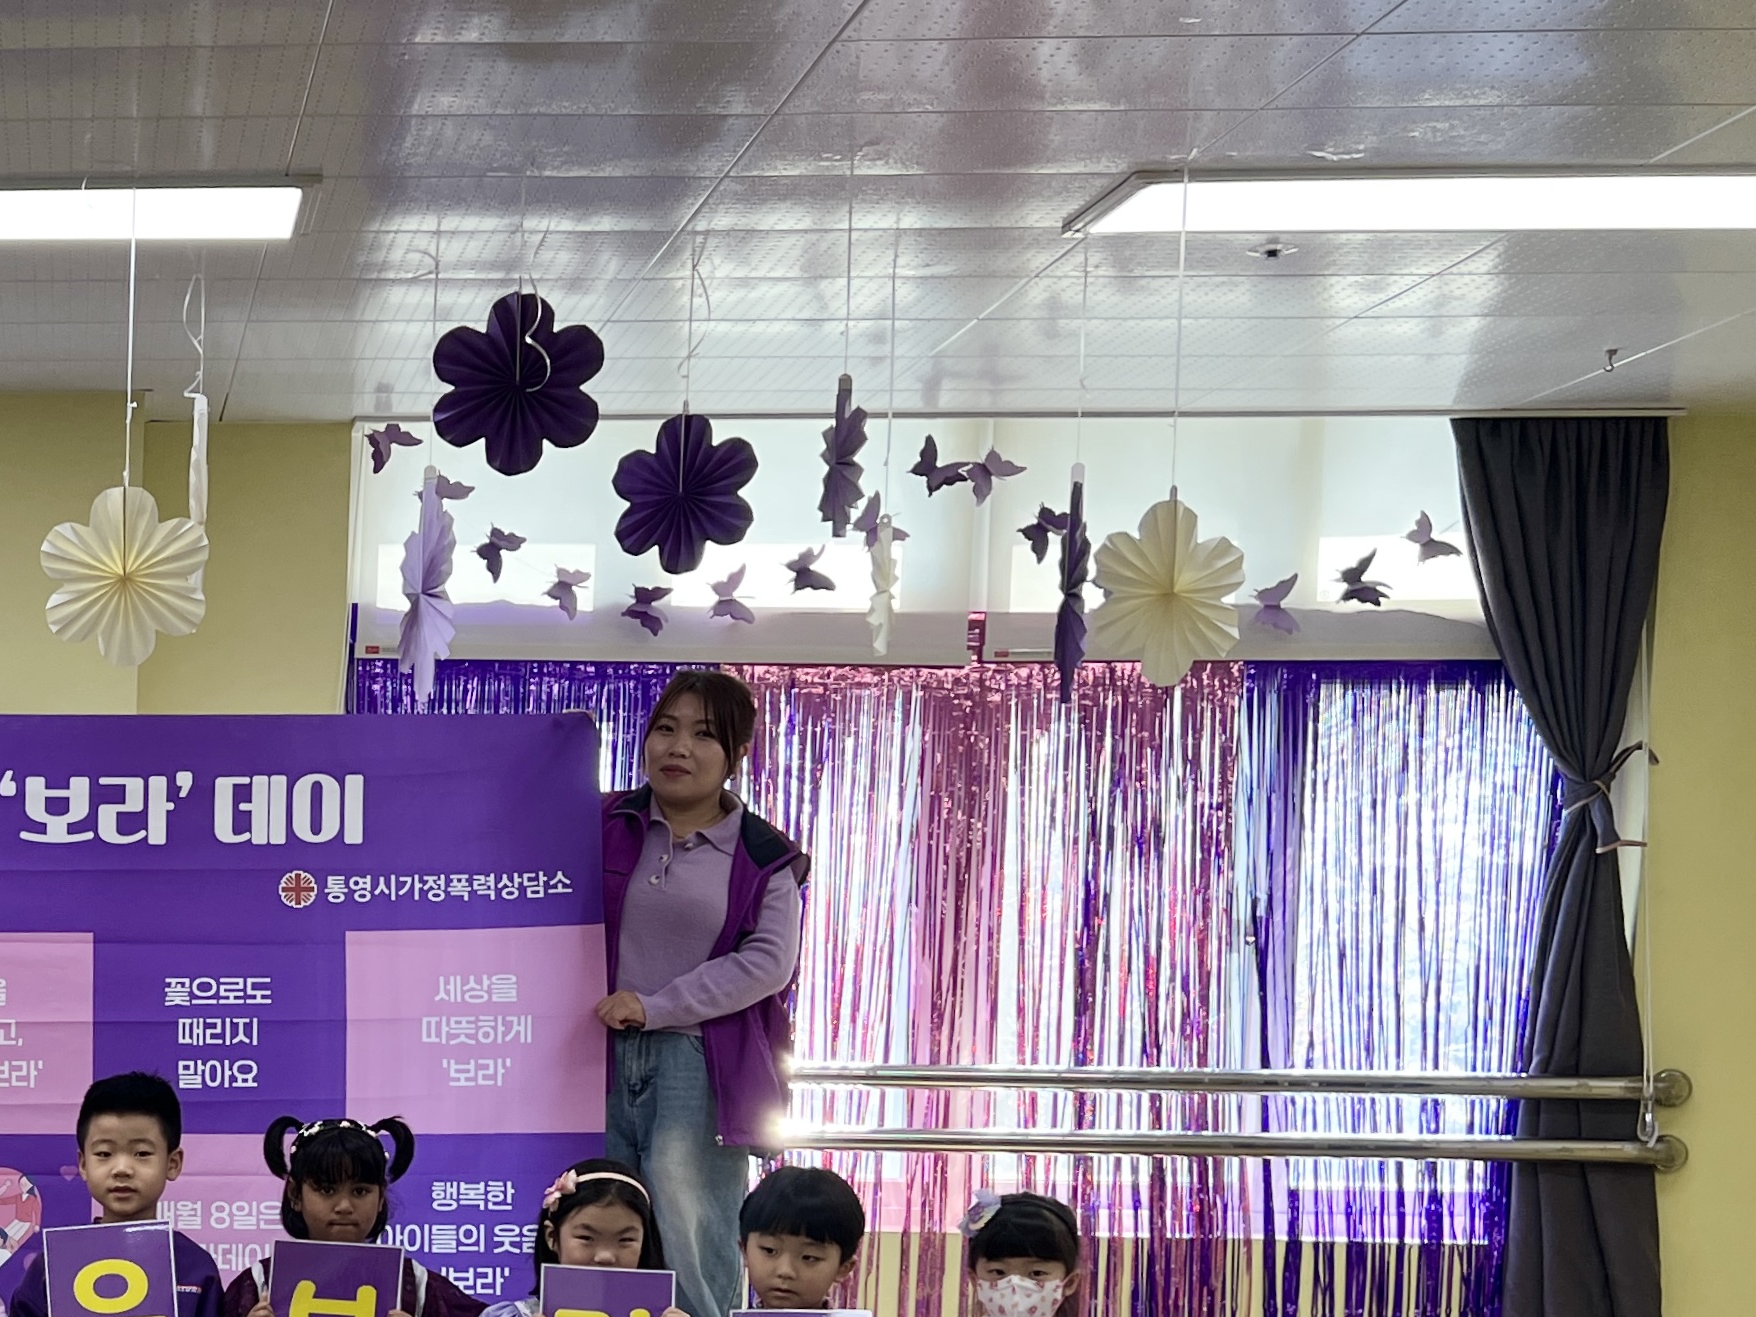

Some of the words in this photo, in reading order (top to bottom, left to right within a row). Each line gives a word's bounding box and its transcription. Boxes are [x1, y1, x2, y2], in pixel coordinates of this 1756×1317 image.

[213, 773, 365, 846] 데이
[323, 870, 574, 903] 통영시가정폭력상담소
[163, 976, 272, 1007] 꽃으로도
[433, 974, 519, 1004] 세상을
[177, 1017, 259, 1047] 때리지
[420, 1014, 533, 1045] 따뜻하게
[176, 1058, 259, 1090] 말아요
[442, 1057, 512, 1087] '보라'
[430, 1179, 516, 1212] 행복한
[492, 1223, 540, 1255] 웃음
